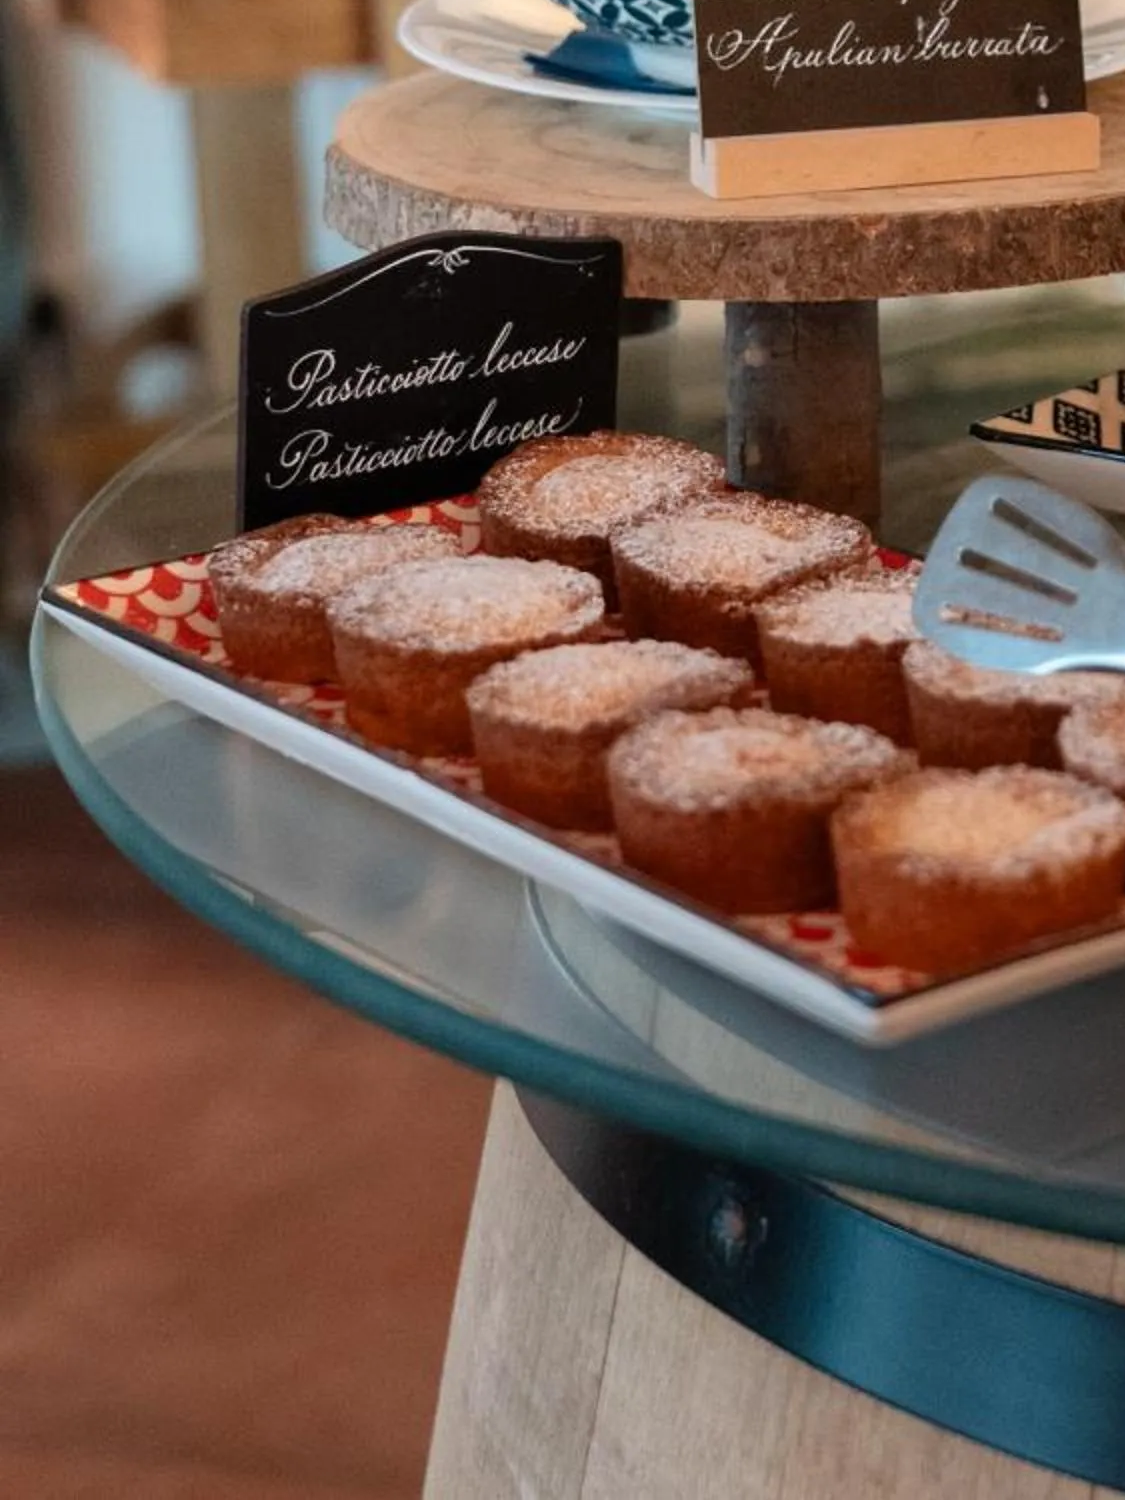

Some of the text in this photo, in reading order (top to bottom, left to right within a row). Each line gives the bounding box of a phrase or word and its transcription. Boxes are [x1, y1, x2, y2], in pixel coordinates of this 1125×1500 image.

[707, 12, 1064, 88] Apulian burrata
[265, 321, 586, 414] Pasticciotto leccese
[265, 398, 584, 489] Pasticciotto leccese
